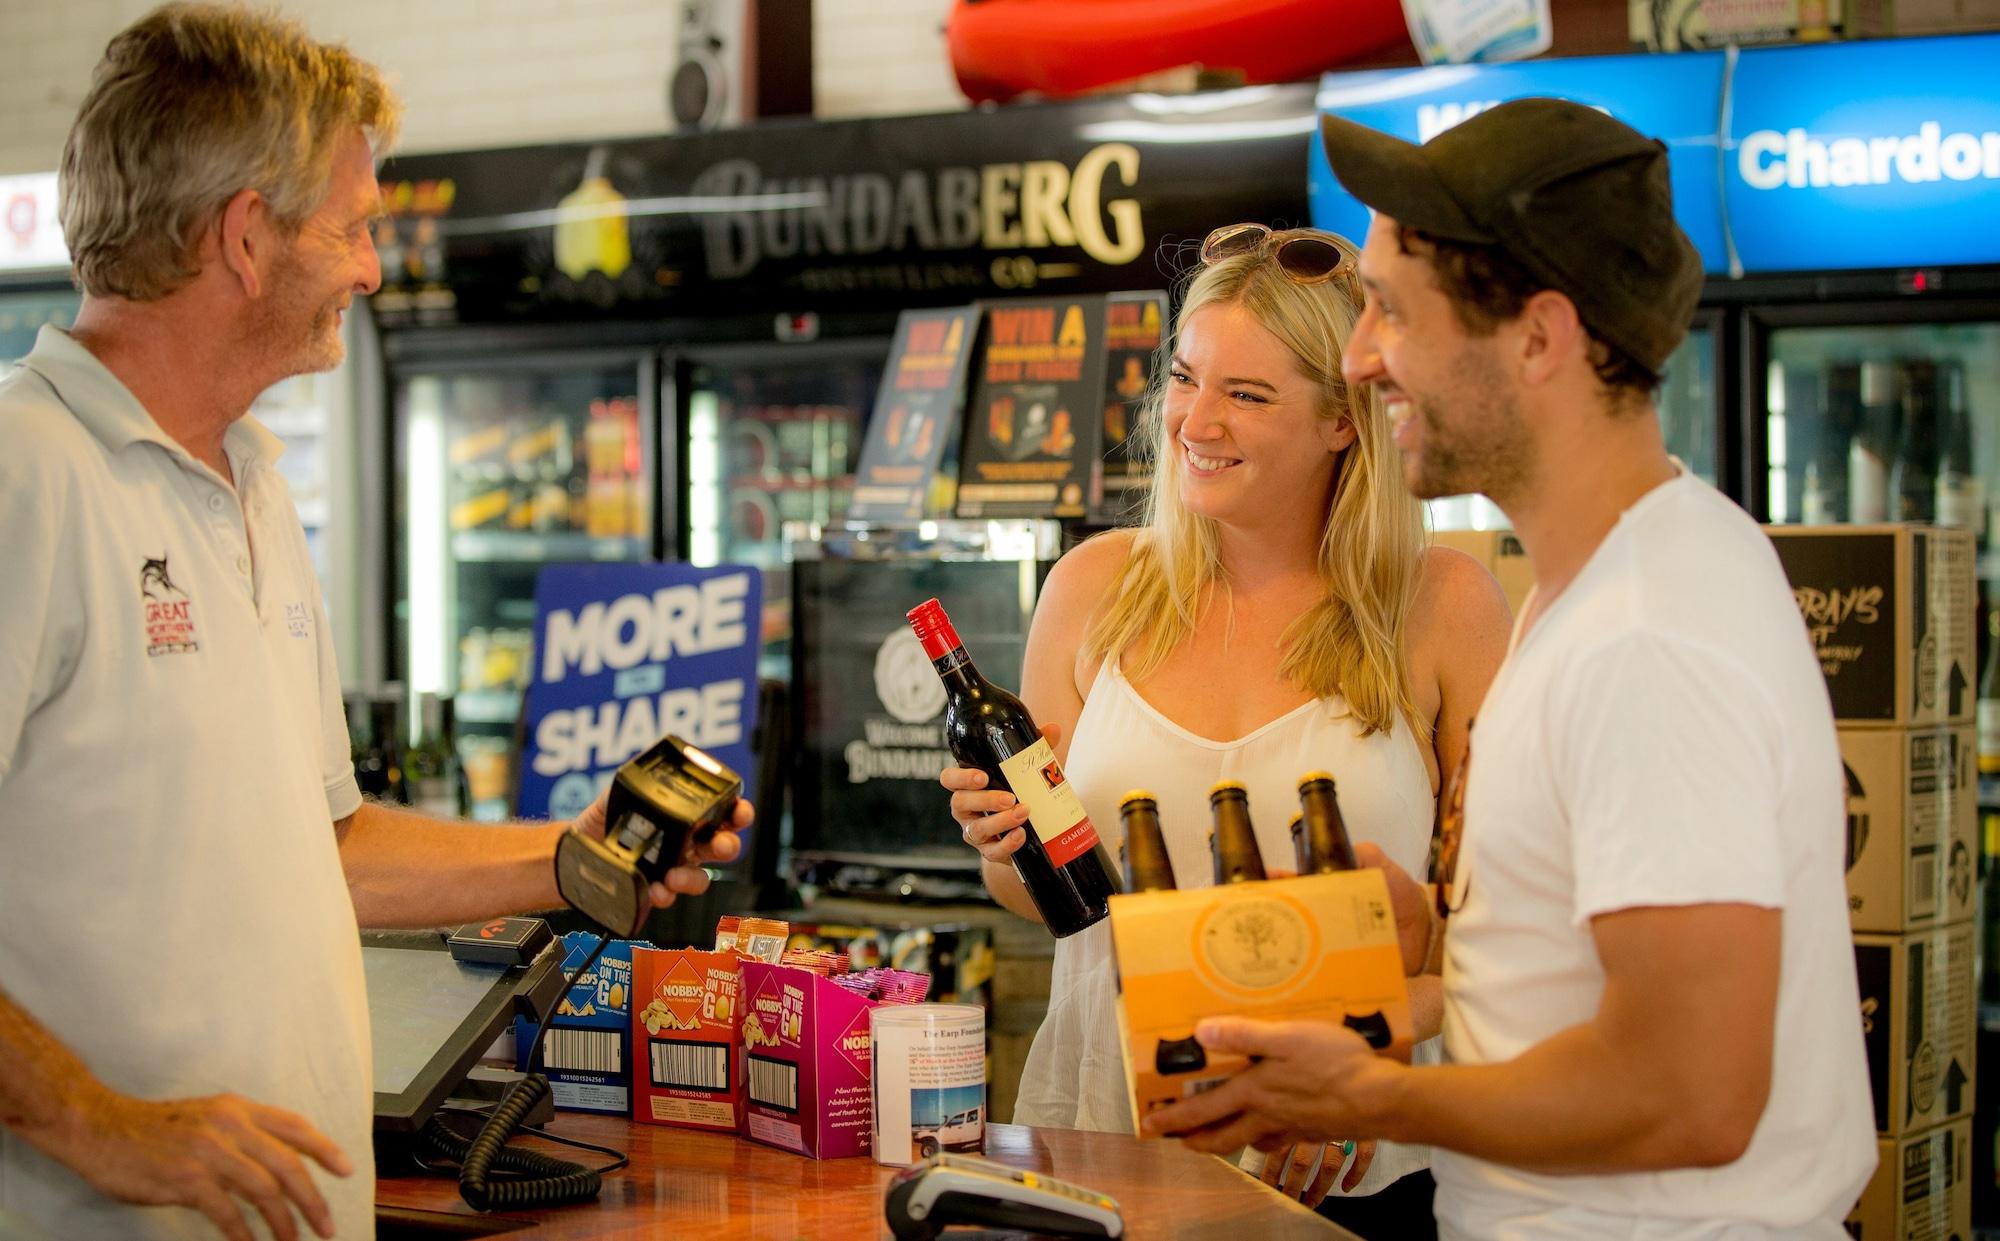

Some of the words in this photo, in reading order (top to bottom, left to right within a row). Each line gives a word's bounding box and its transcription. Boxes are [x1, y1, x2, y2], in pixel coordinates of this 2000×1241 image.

[692, 143, 1145, 280] BUNDABERG
[992, 307, 1056, 344] WIN
[1058, 304, 1087, 346] A
[146, 601, 190, 622] GREAT
[542, 572, 750, 683] MORE
[533, 679, 744, 777] SHARE
[600, 966, 612, 980] ON
[614, 969, 630, 984] THE
[706, 978, 718, 992] ON
[720, 981, 737, 996] THE
[783, 994, 792, 1009] ON
[792, 998, 804, 1015] THE
[843, 1036, 870, 1050] NOB
[941, 1030, 959, 1038] Earp
[828, 1097, 854, 1107] Nobby's
